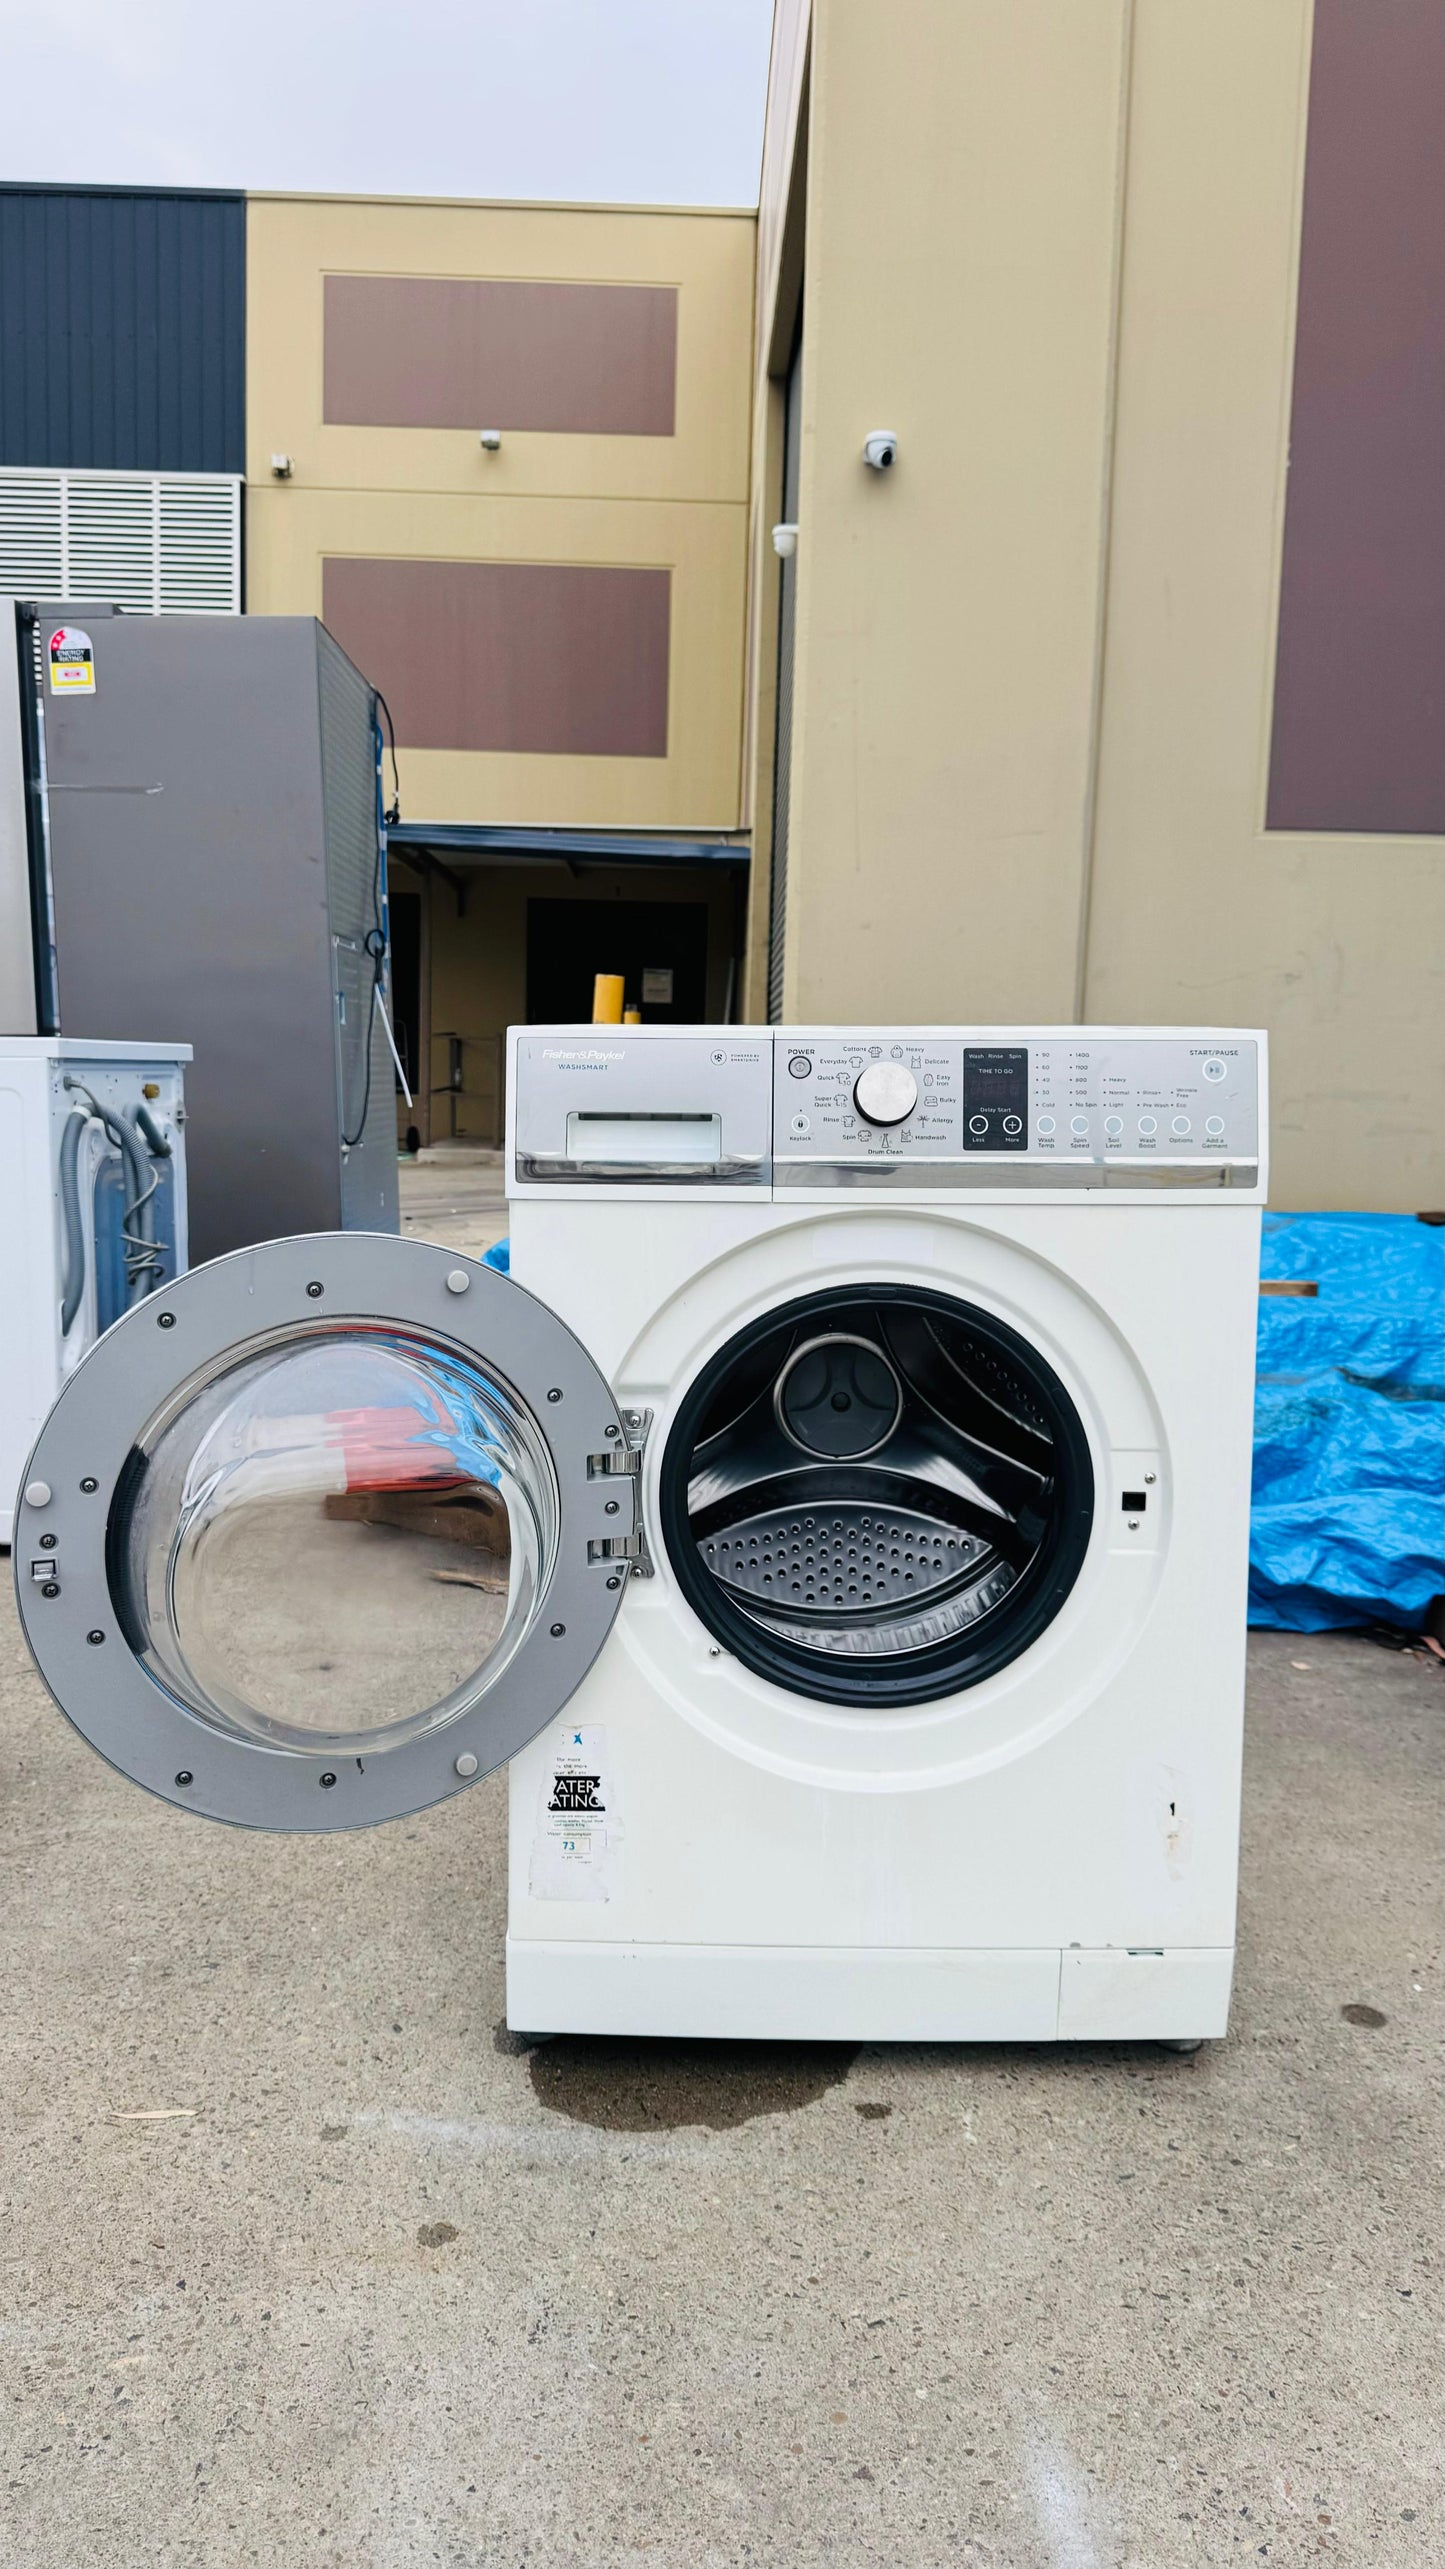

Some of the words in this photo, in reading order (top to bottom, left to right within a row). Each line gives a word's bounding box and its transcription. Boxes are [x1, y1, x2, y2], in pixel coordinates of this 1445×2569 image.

[556, 1780, 595, 1793] ATER
[550, 1794, 602, 1807] ATING
[562, 1841, 575, 1850] 73
